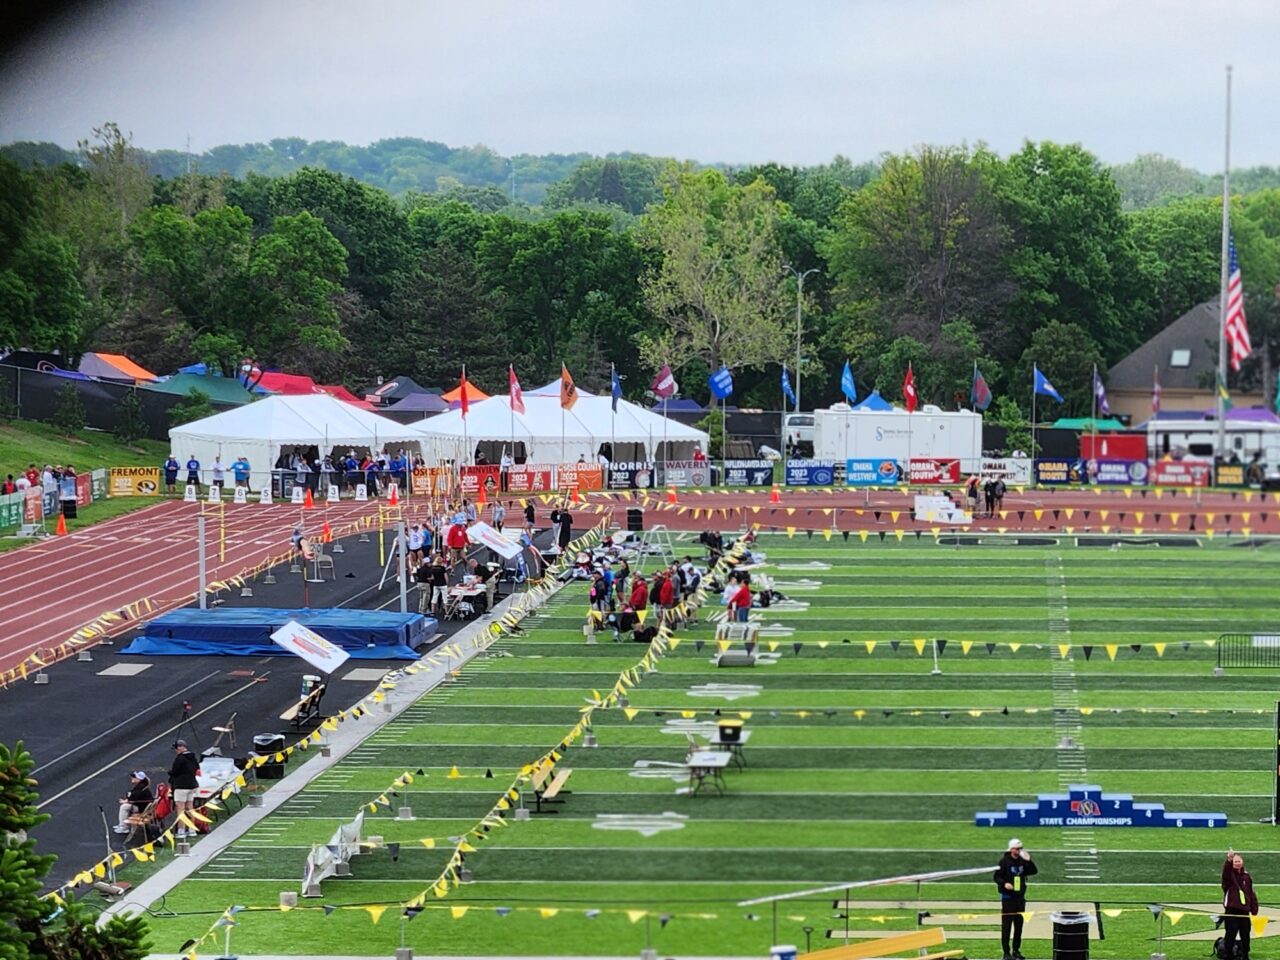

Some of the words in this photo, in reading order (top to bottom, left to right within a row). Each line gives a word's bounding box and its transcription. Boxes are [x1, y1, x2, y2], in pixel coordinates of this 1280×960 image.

[577, 463, 602, 472] COUNTY
[610, 461, 654, 470] NORRIS
[666, 461, 709, 469] WAVERLY
[787, 460, 820, 468] CREIGHTON
[853, 462, 873, 471] OMAHA
[911, 462, 935, 471] OMAHA
[983, 462, 1006, 470] OMAHA
[1038, 463, 1068, 471] OMAHA
[111, 467, 159, 477] FREMONT
[612, 472, 629, 480] 2023
[668, 470, 685, 478] 2023
[911, 471, 934, 480] SOUTH
[511, 474, 527, 482] 2023
[1083, 791, 1088, 799] 1
[1052, 800, 1057, 809] 3
[1113, 800, 1119, 809] 2
[1020, 809, 1026, 818] 5
[1146, 809, 1152, 818] 4
[989, 818, 995, 827] 7
[1039, 817, 1064, 826] STATE
[1066, 817, 1133, 826] CHAMPIONSHIPS
[1177, 818, 1182, 828] 6
[1207, 818, 1214, 828] 8
